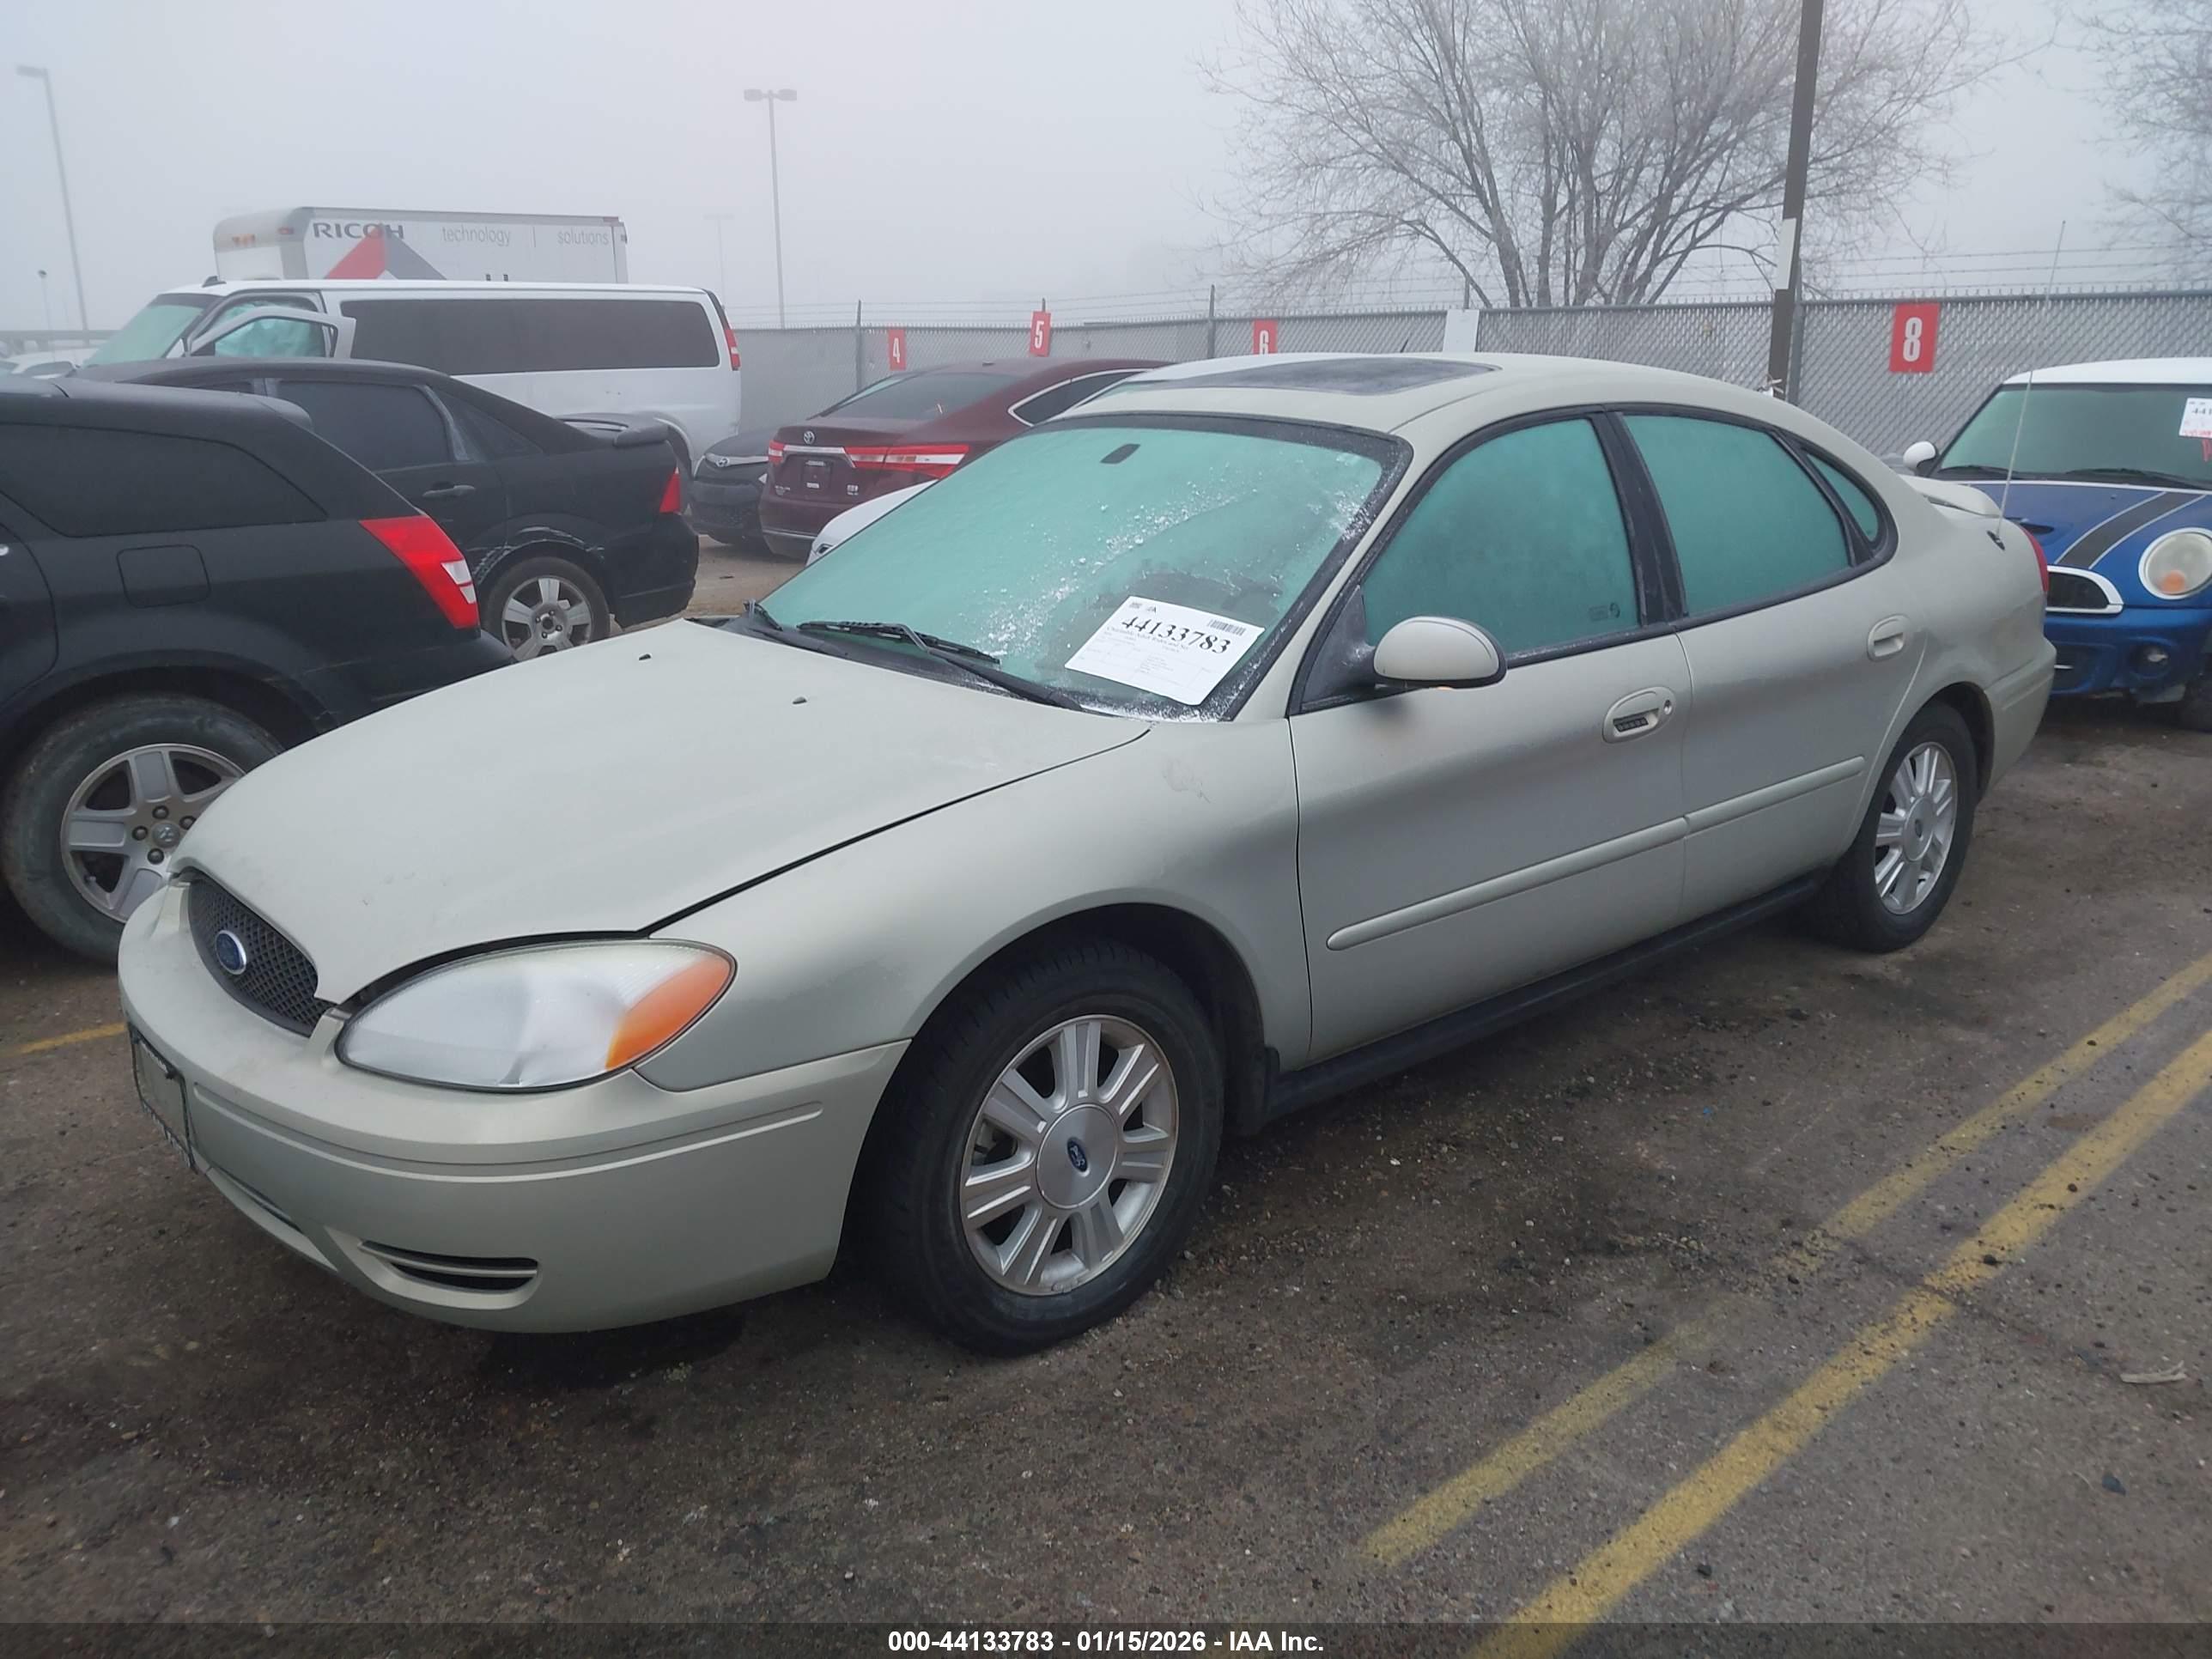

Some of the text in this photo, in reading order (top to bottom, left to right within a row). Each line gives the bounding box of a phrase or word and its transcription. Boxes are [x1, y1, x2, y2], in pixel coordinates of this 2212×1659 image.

[313, 222, 610, 247] RICOH technology solutions
[1034, 320, 1045, 349] 5
[1903, 317, 1923, 362] 8
[892, 337, 901, 363] 4
[1121, 616, 1231, 653] 44133783
